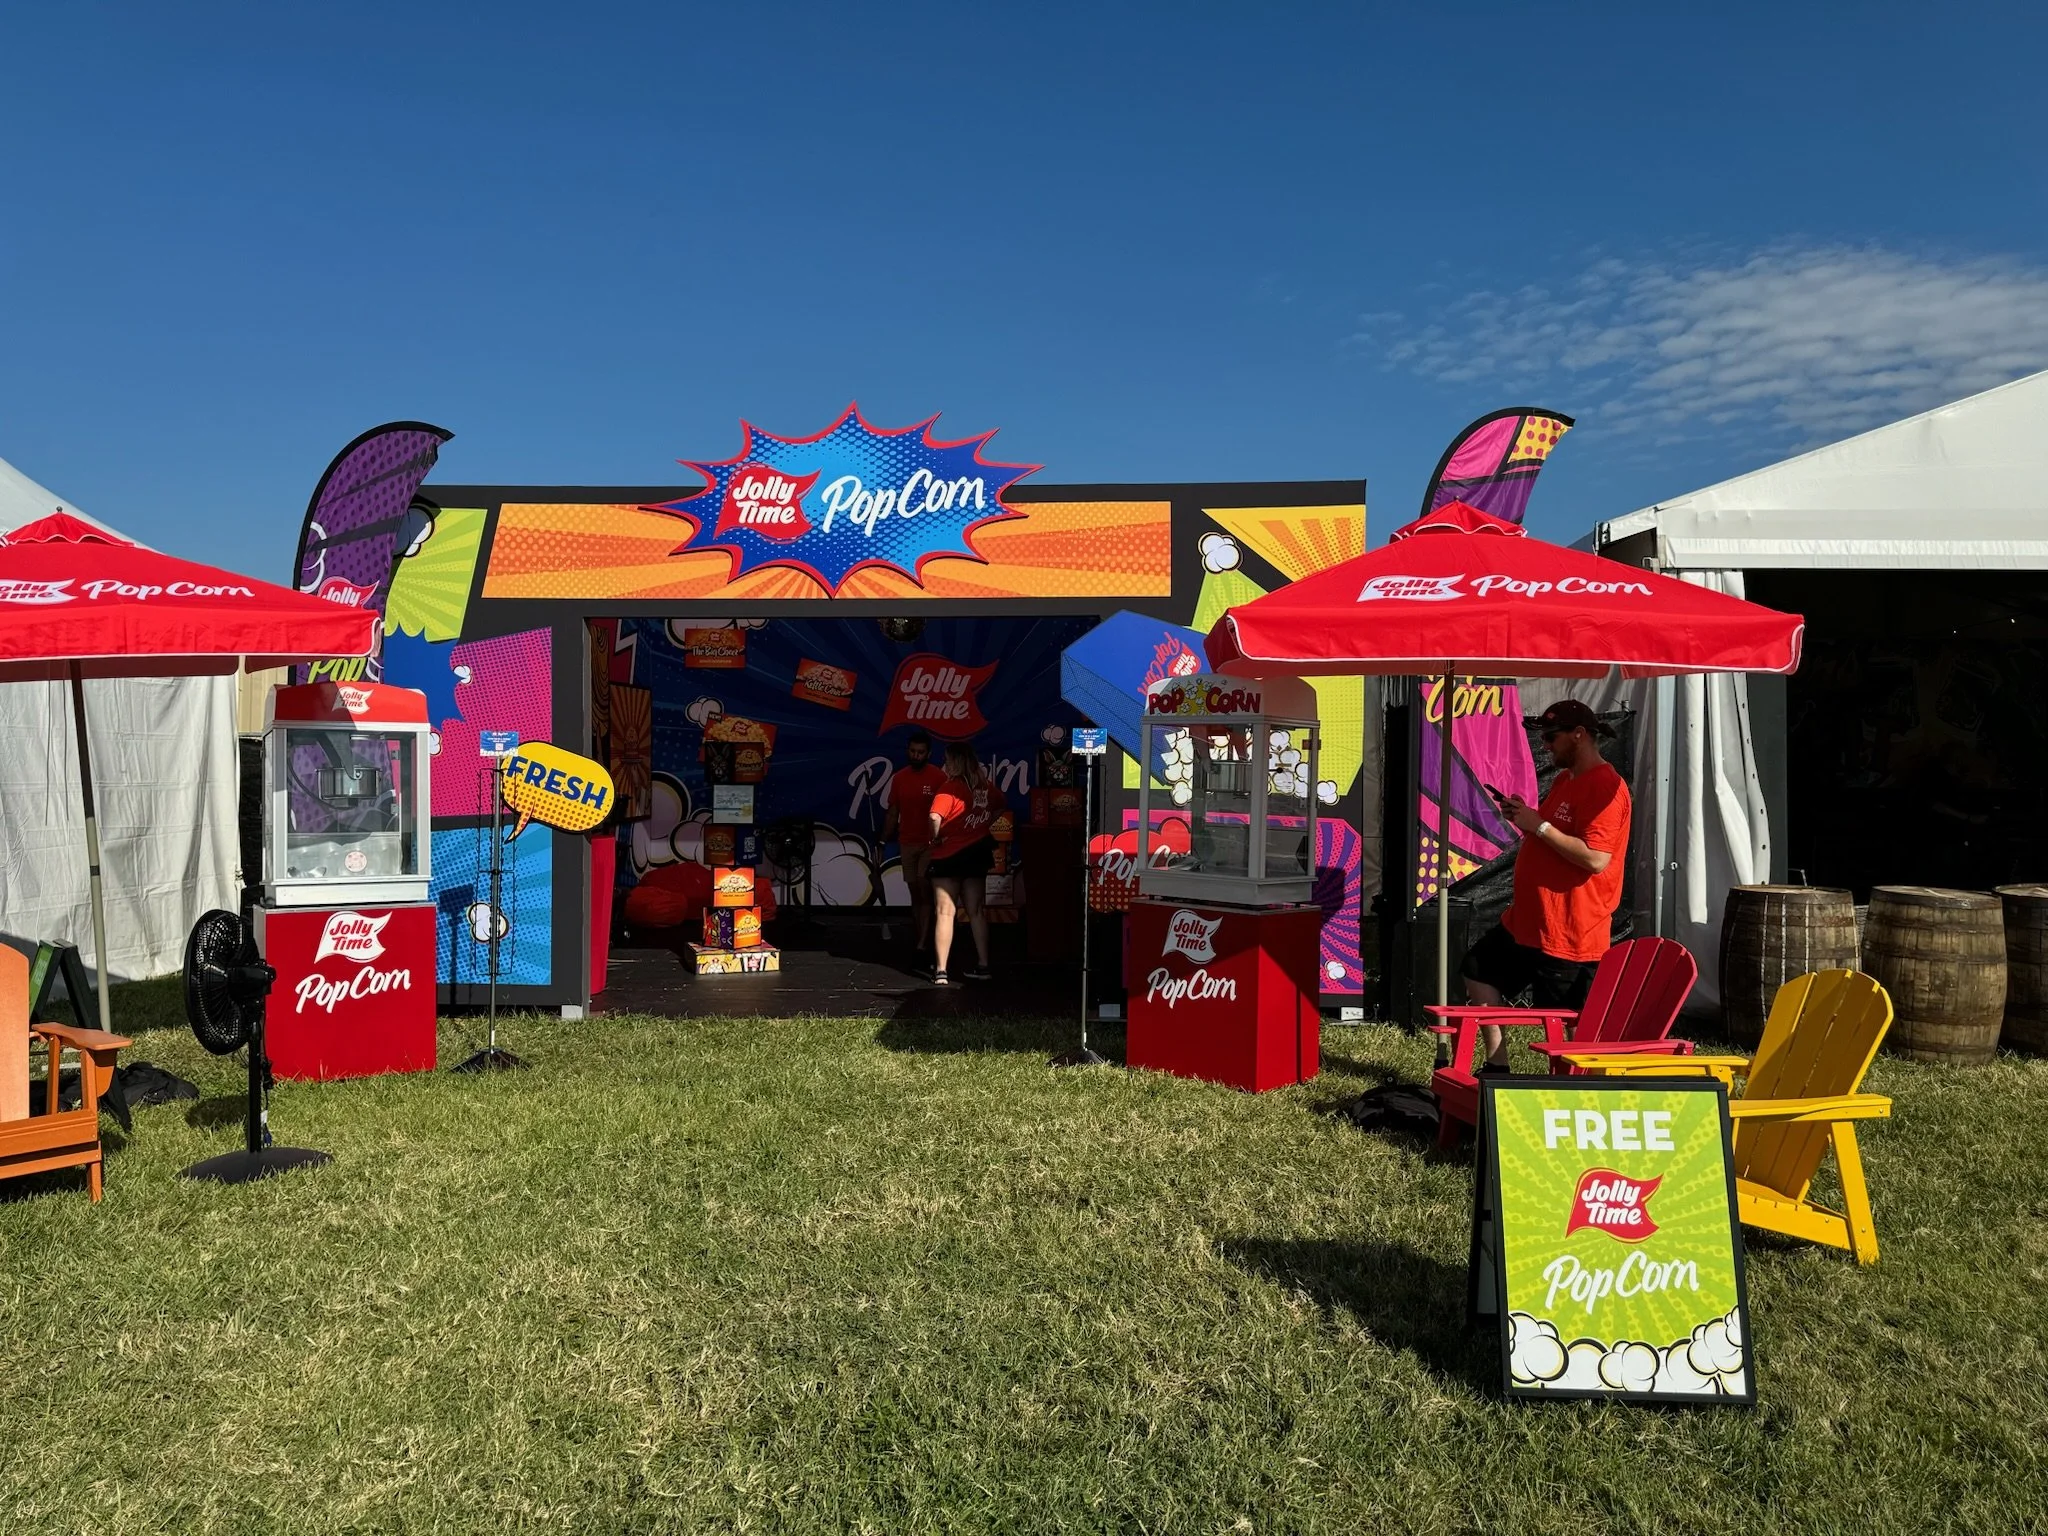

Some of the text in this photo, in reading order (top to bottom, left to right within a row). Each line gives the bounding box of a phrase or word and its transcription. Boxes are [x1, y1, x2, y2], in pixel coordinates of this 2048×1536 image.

[732, 476, 797, 505] Jolly
[821, 468, 985, 537] Pop Corn
[736, 500, 796, 524] Time
[0, 583, 49, 592] olly
[81, 579, 255, 600] Pop Corn
[1373, 579, 1440, 589] Jolly
[1376, 588, 1446, 596] Time
[1470, 575, 1653, 598] Pop Corn
[340, 691, 363, 700] Jolly
[900, 667, 971, 700] Jolly
[341, 699, 363, 708] Time
[904, 694, 970, 720] Time
[1148, 687, 1186, 714] POP
[506, 756, 608, 810] FRESH
[329, 920, 374, 937] Jolly
[1174, 918, 1208, 938] Jolly
[332, 936, 372, 951] Time
[1175, 934, 1206, 950] Time
[295, 966, 411, 1014] Pop Corn
[1147, 968, 1236, 1009] Pop Corn
[1543, 1109, 1674, 1150] FREE
[1581, 1179, 1641, 1207] Jolly
[1585, 1201, 1642, 1225] Time
[1542, 1250, 1700, 1315] Pop Corn
